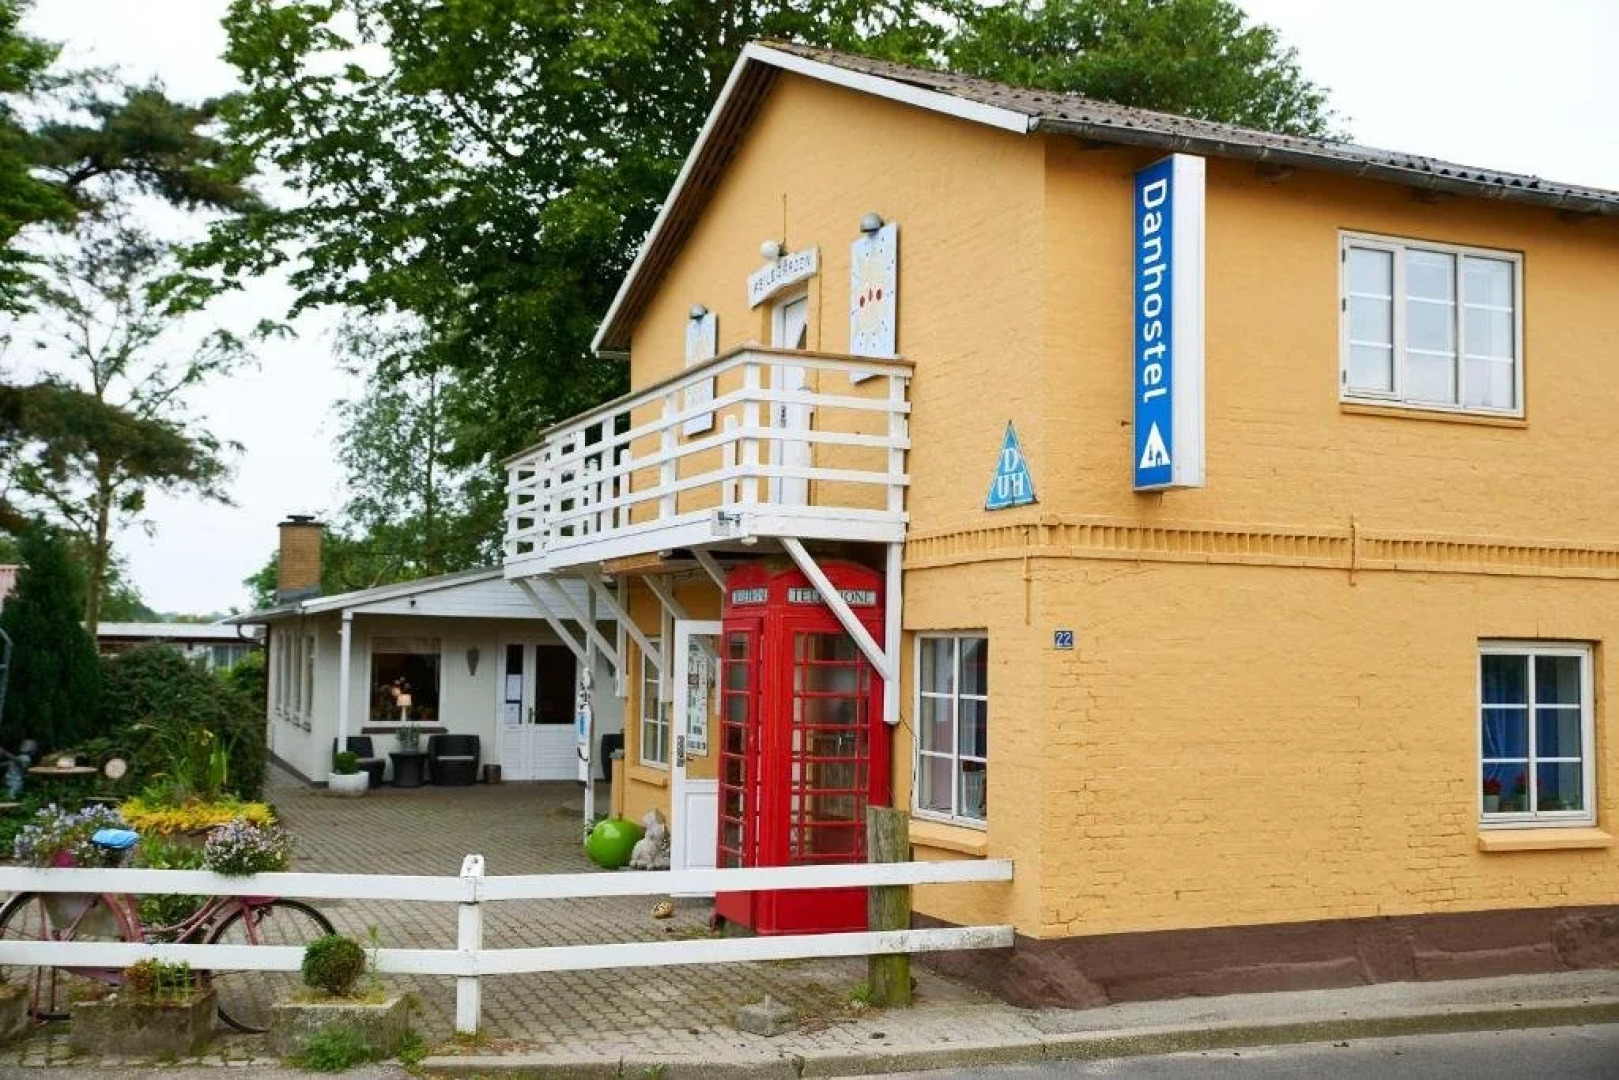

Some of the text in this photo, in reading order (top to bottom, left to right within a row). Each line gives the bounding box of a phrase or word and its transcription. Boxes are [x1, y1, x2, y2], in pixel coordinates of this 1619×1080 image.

[1143, 178, 1167, 403] Danhostel
[1004, 448, 1019, 472] D
[998, 472, 1024, 498] UH
[792, 589, 874, 604] TELONE
[1056, 632, 1071, 646] 22
